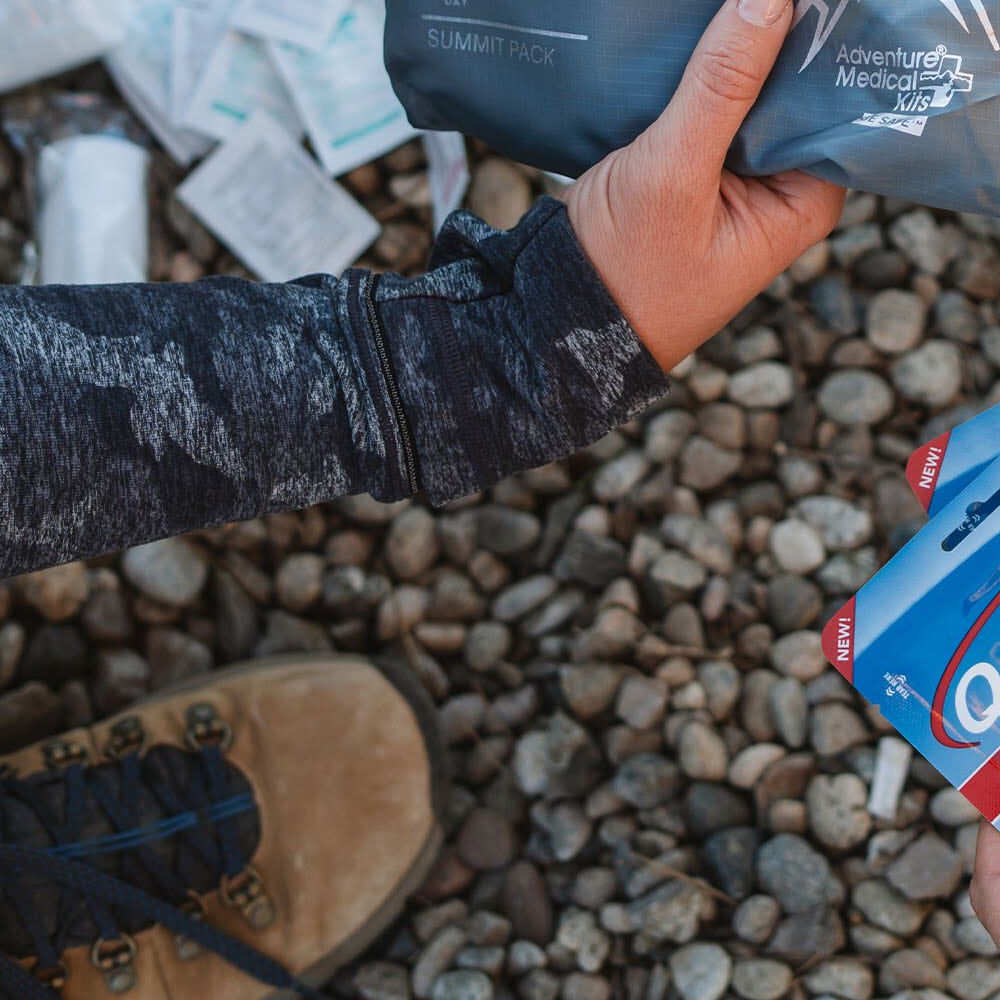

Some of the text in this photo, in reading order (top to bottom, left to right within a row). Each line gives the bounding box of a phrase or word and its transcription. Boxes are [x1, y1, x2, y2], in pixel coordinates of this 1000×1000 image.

[427, 28, 556, 67] SUMMIT PACK
[835, 65, 918, 92] Medical
[892, 93, 932, 112] Kits
[919, 447, 942, 488] NEW!
[837, 617, 851, 661] NEW!
